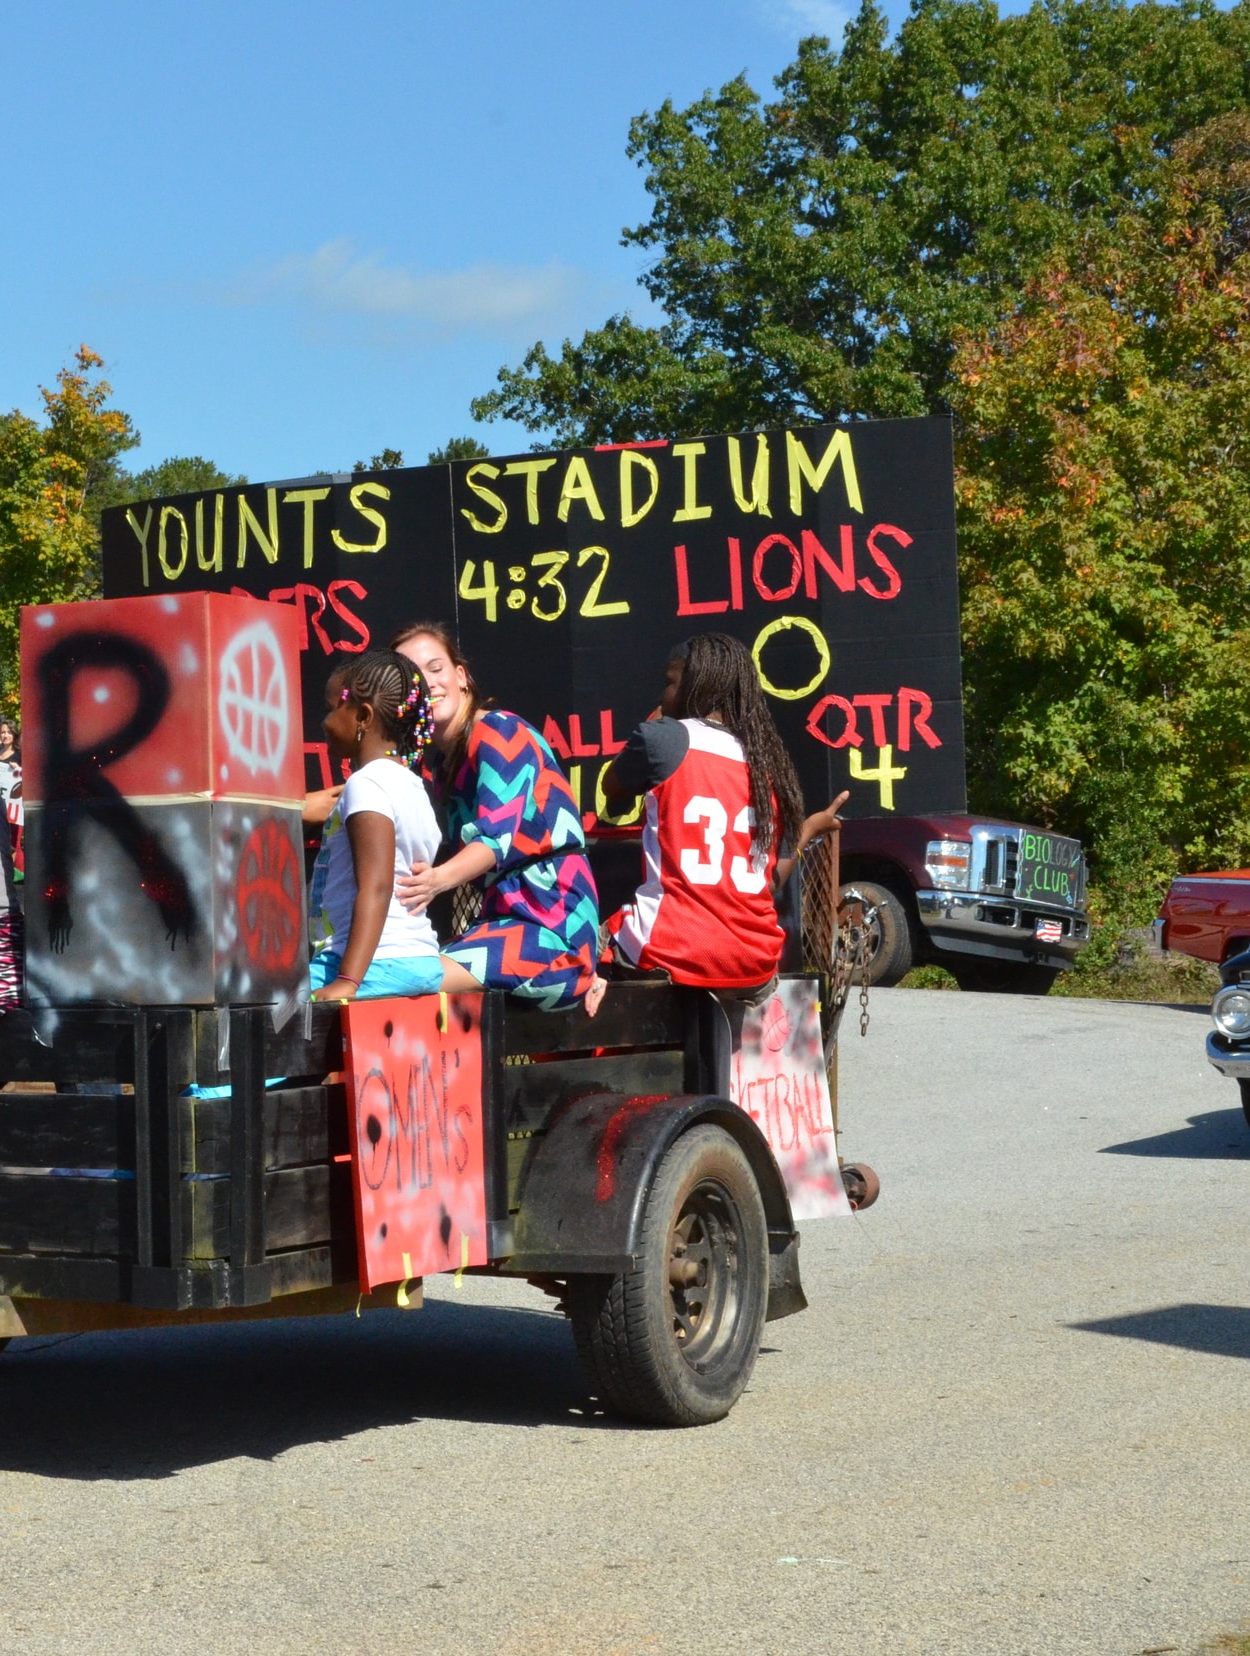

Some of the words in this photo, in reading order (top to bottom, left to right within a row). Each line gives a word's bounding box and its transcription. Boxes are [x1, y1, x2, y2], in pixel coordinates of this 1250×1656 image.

[126, 482, 390, 587] YOUNTS
[461, 429, 863, 534] STADIUM
[459, 546, 630, 622] 4:32
[674, 523, 913, 616] LIONS
[541, 709, 629, 759] ALL
[806, 687, 942, 751] QTR
[38, 631, 197, 952] R
[850, 744, 907, 811] 4
[1025, 834, 1077, 867] BIOLOGY
[1034, 866, 1069, 896] CLUB
[355, 1048, 473, 1190] OMEN'S
